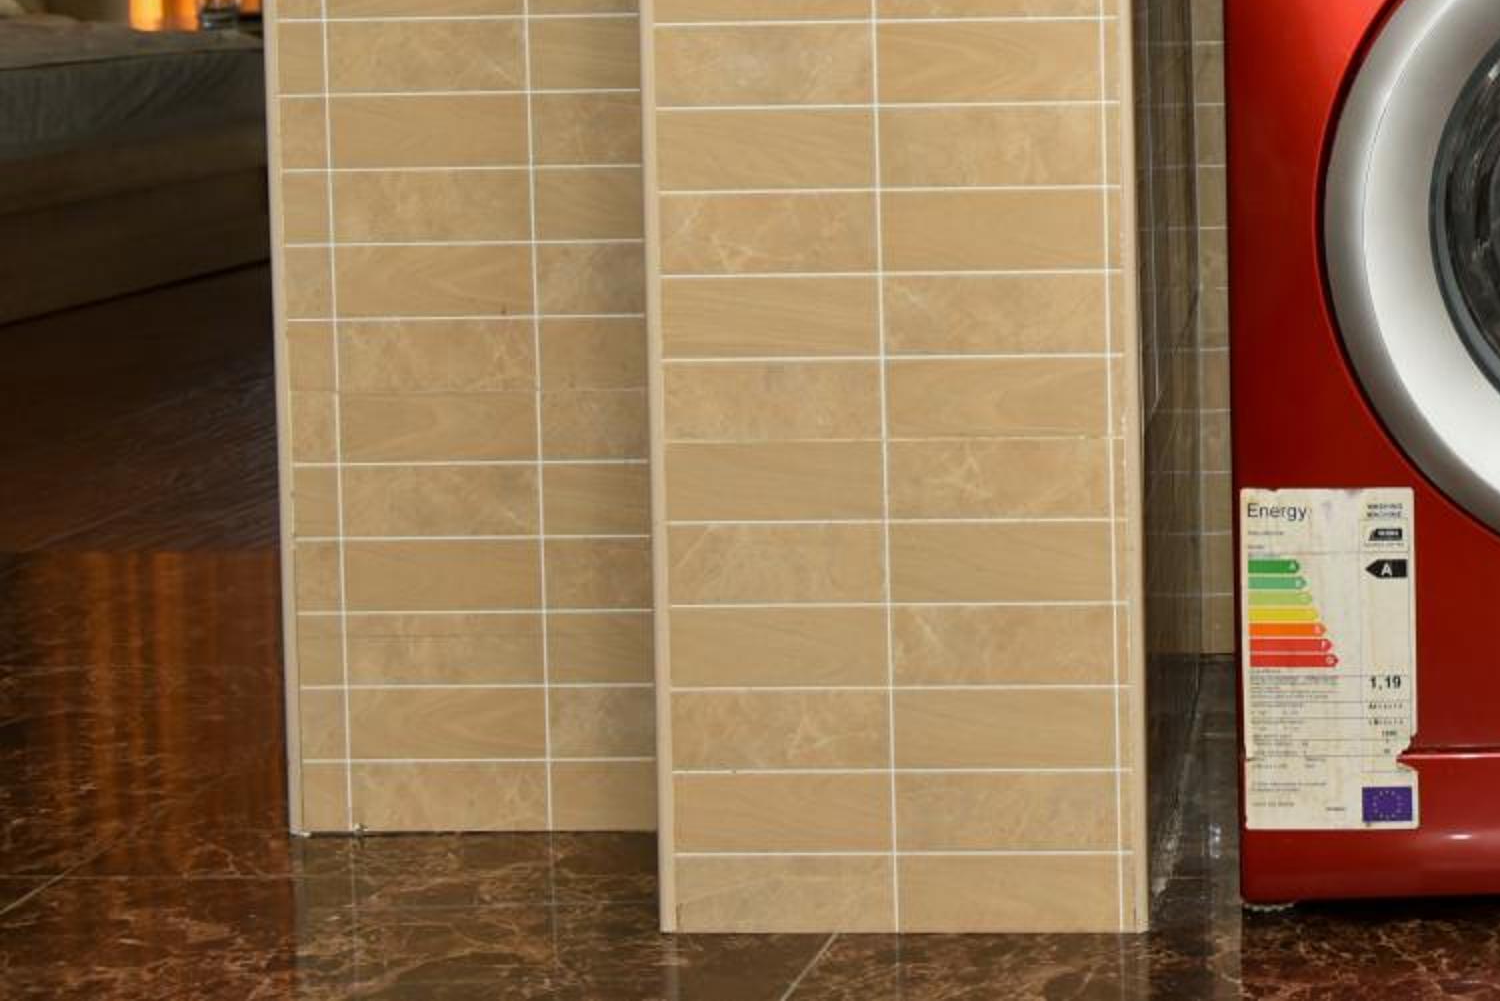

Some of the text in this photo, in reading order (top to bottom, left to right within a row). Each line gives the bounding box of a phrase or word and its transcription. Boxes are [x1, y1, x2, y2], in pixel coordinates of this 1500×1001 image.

[1247, 502, 1307, 521] Energy
[1380, 561, 1393, 577] A
[1369, 675, 1402, 691] 1,19
